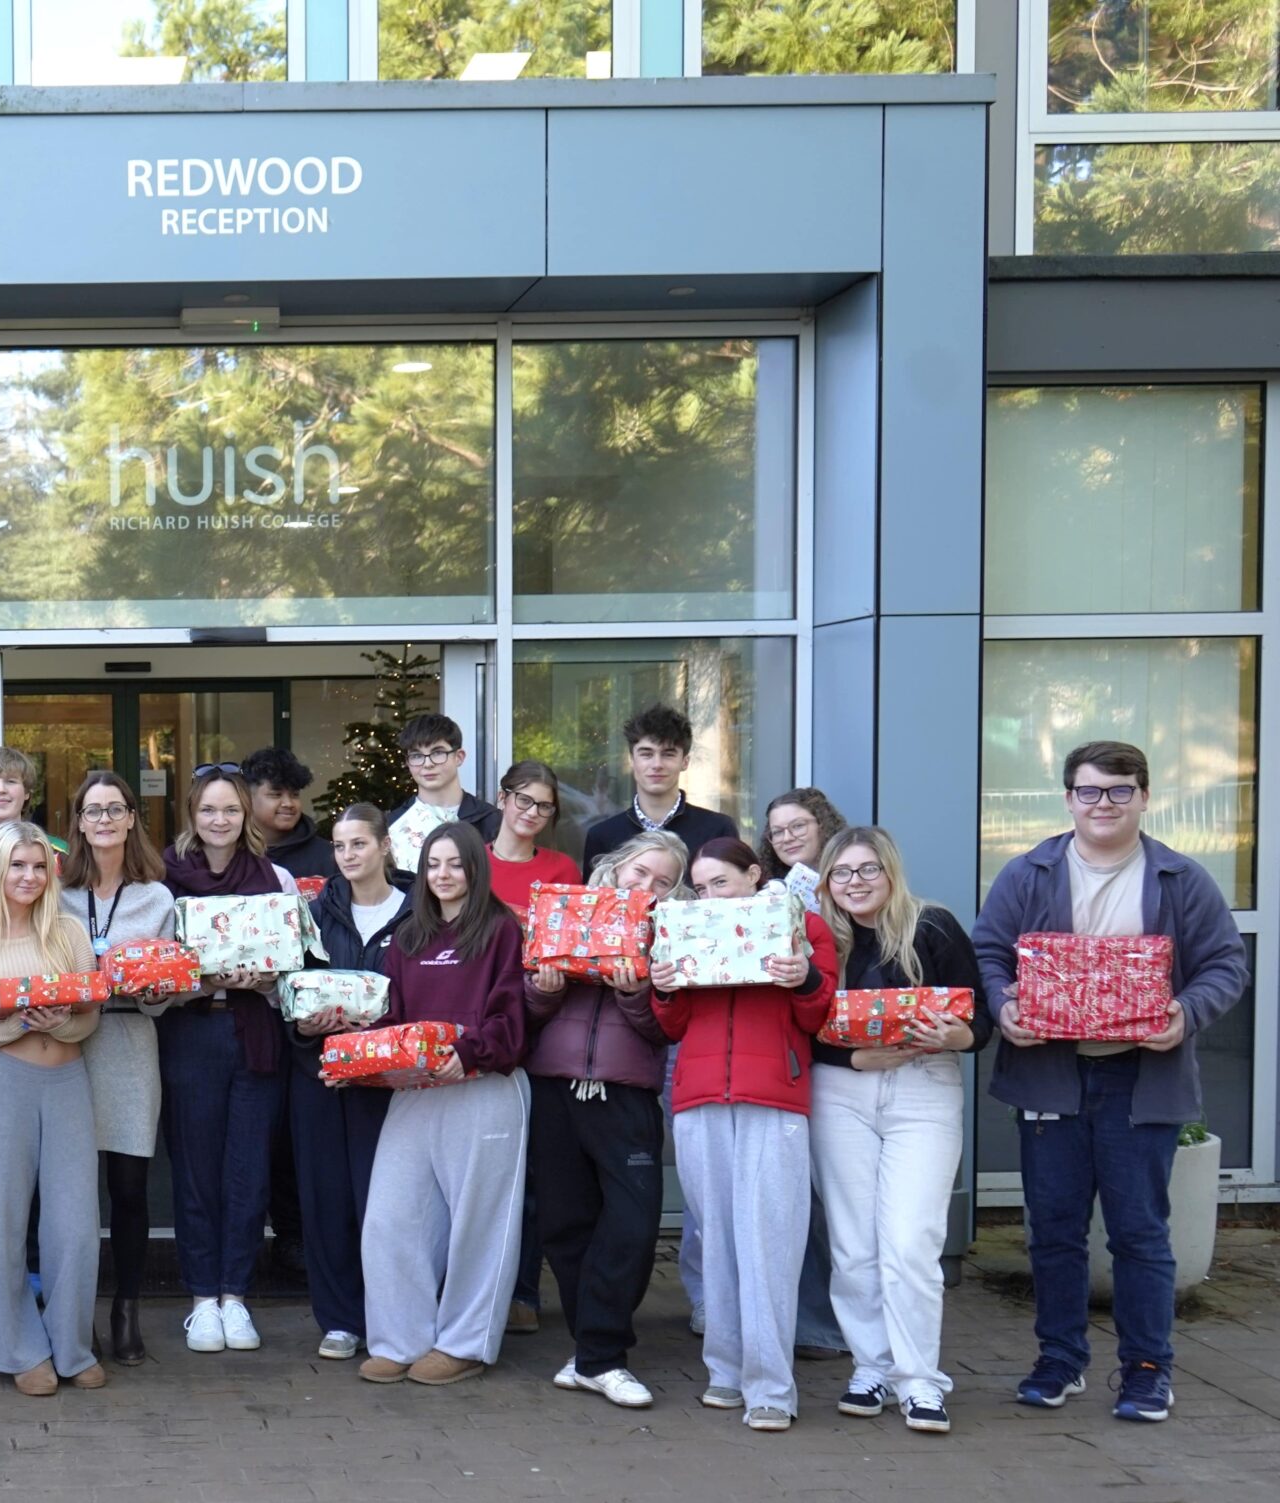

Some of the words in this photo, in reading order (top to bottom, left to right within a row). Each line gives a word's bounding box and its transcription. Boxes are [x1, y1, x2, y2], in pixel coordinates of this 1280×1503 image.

[127, 156, 363, 197] REDWOOD
[161, 207, 328, 235] RECEPTION
[110, 420, 340, 507] huish
[110, 516, 190, 530] RICHARD
[198, 515, 253, 529] HUISH
[260, 514, 341, 529] COLLEGE
